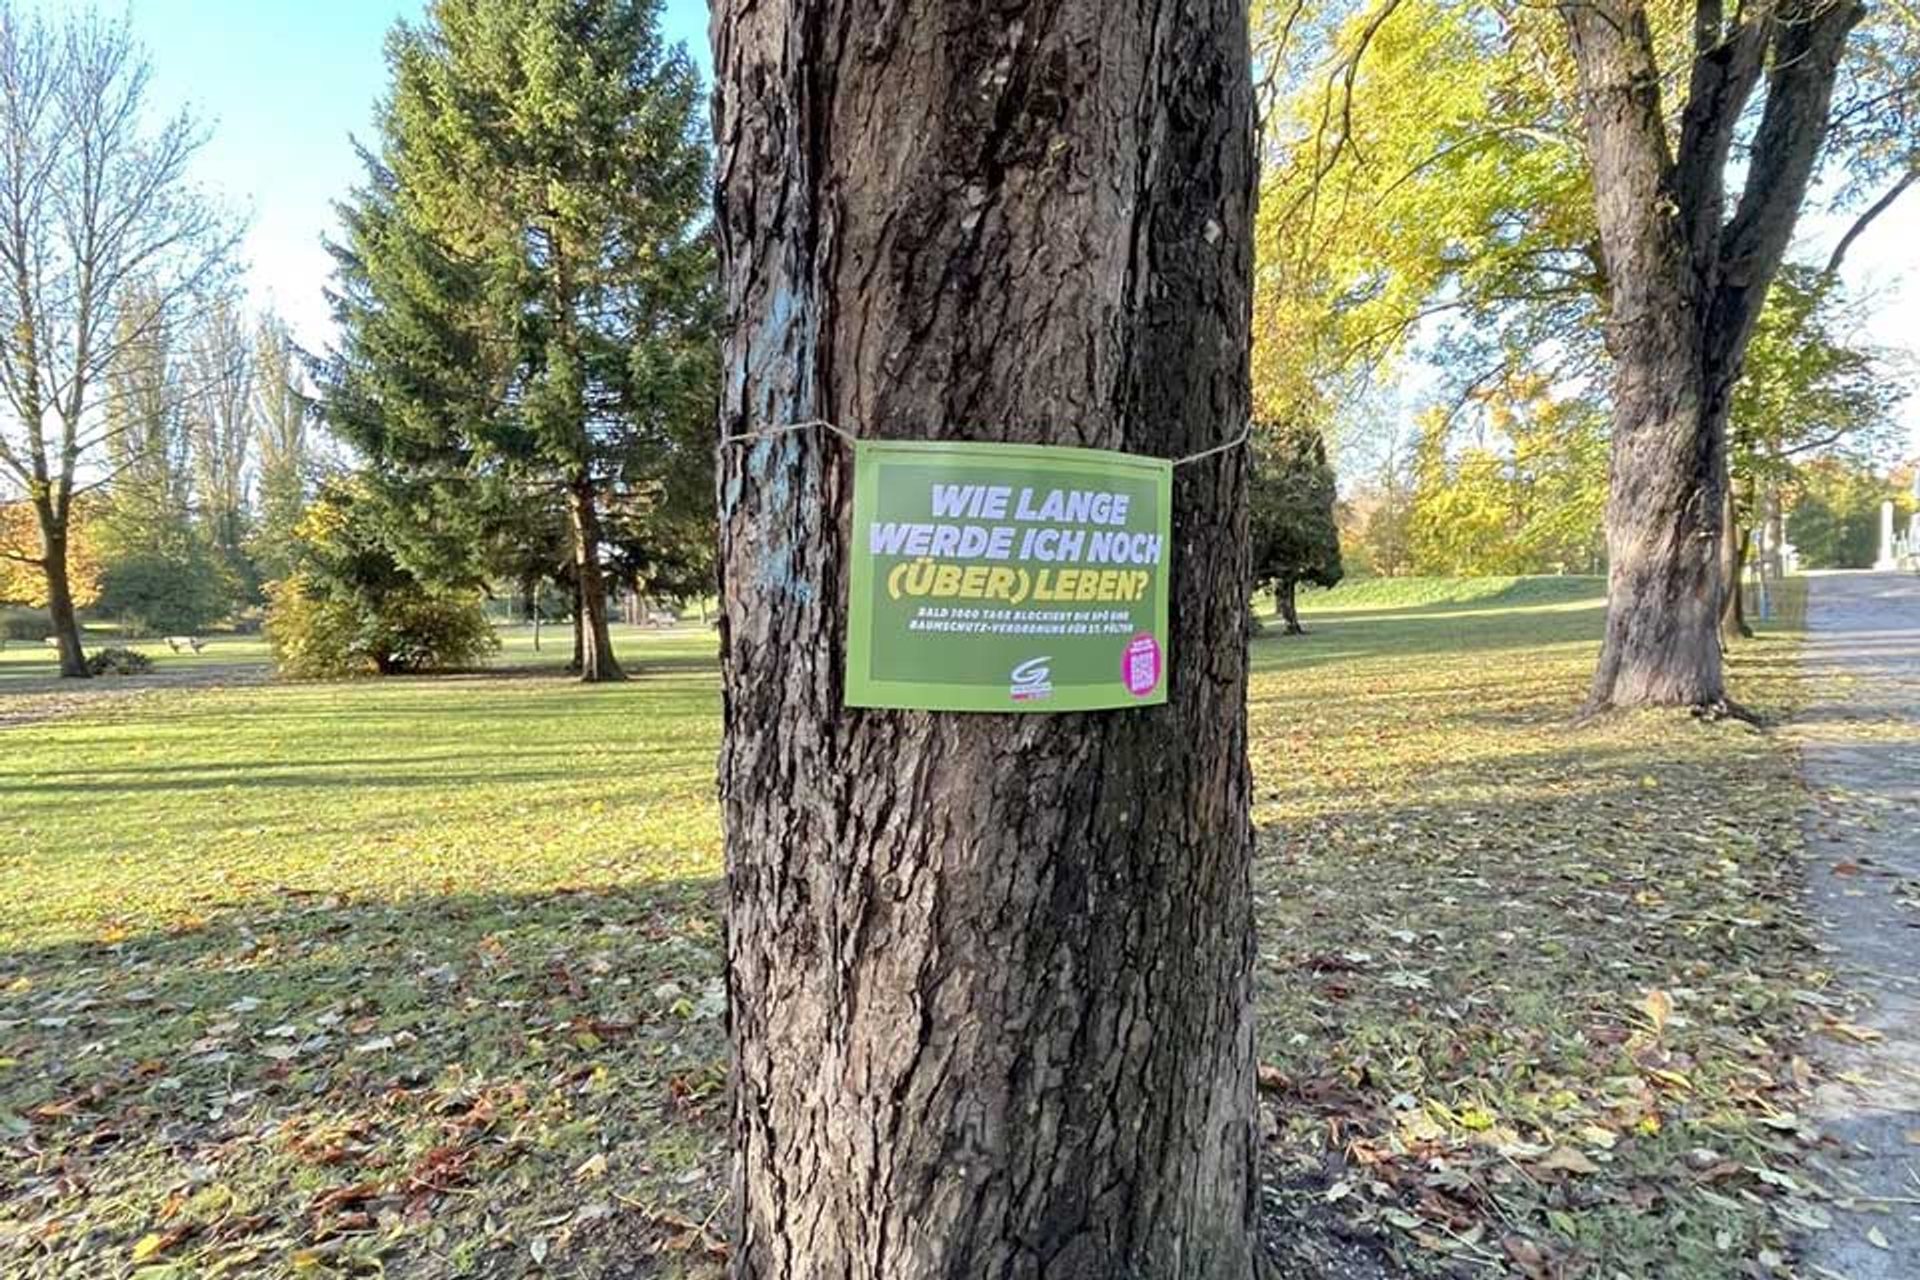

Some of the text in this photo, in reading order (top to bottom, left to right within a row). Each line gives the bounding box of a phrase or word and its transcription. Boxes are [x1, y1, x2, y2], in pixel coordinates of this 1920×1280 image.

[932, 484, 1130, 525] WIE LANGE
[869, 522, 1163, 565] WERDE ICH NOCH
